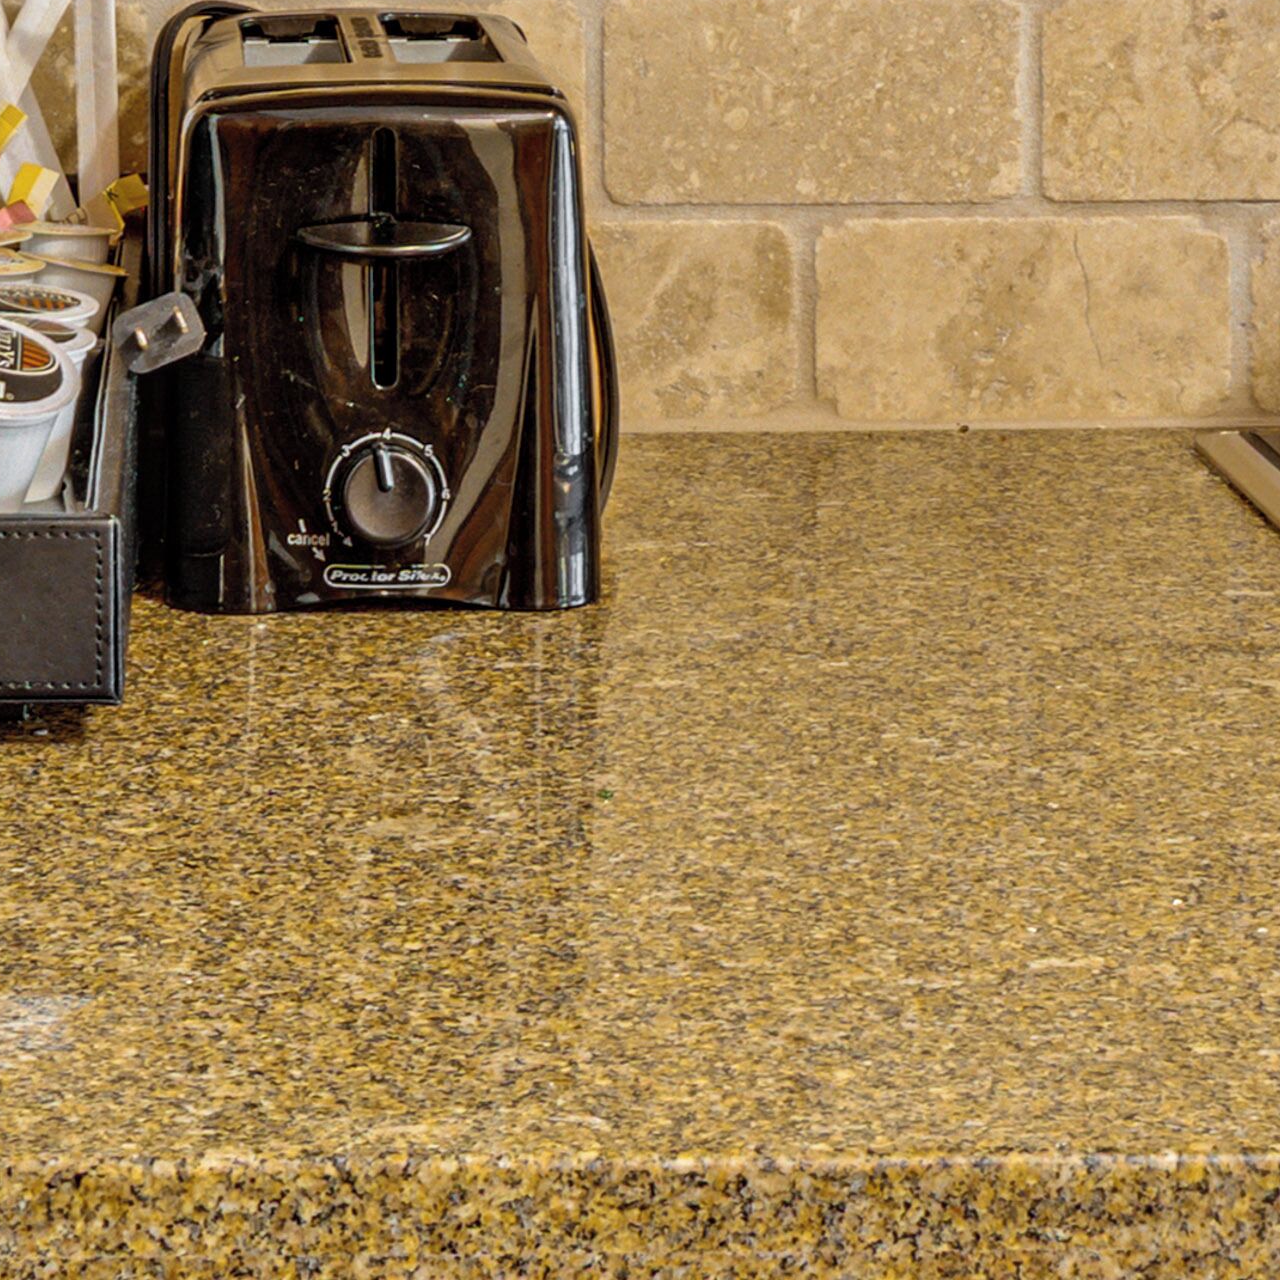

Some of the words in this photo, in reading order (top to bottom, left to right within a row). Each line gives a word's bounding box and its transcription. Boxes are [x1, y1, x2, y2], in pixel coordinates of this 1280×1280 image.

[382, 427, 392, 440] 4
[341, 444, 351, 457] 3
[424, 444, 433, 457] 5
[323, 488, 331, 502] 2
[441, 488, 451, 500] 6
[287, 532, 330, 547] cancel
[330, 569, 396, 582] Proctor
